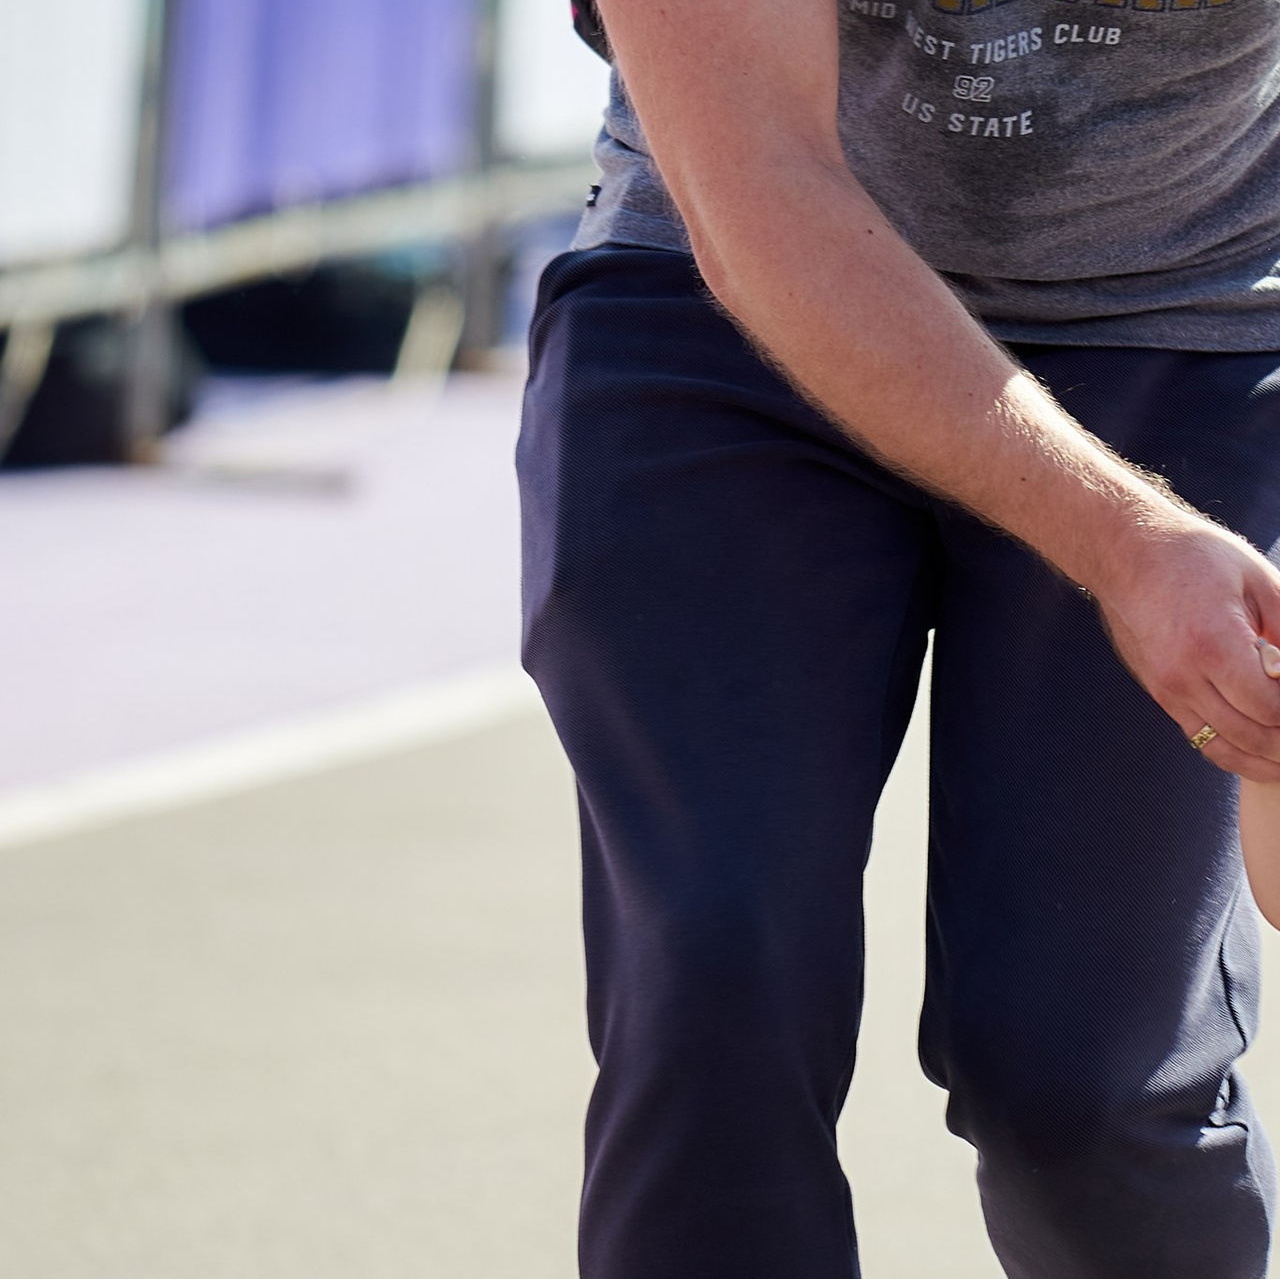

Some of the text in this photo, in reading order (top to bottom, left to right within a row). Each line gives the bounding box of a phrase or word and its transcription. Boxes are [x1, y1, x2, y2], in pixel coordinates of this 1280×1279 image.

[969, 26, 1043, 65] TIGERS
[1053, 23, 1122, 46] CLUB
[952, 74, 995, 103] 92
[901, 93, 1034, 138] US STATE
